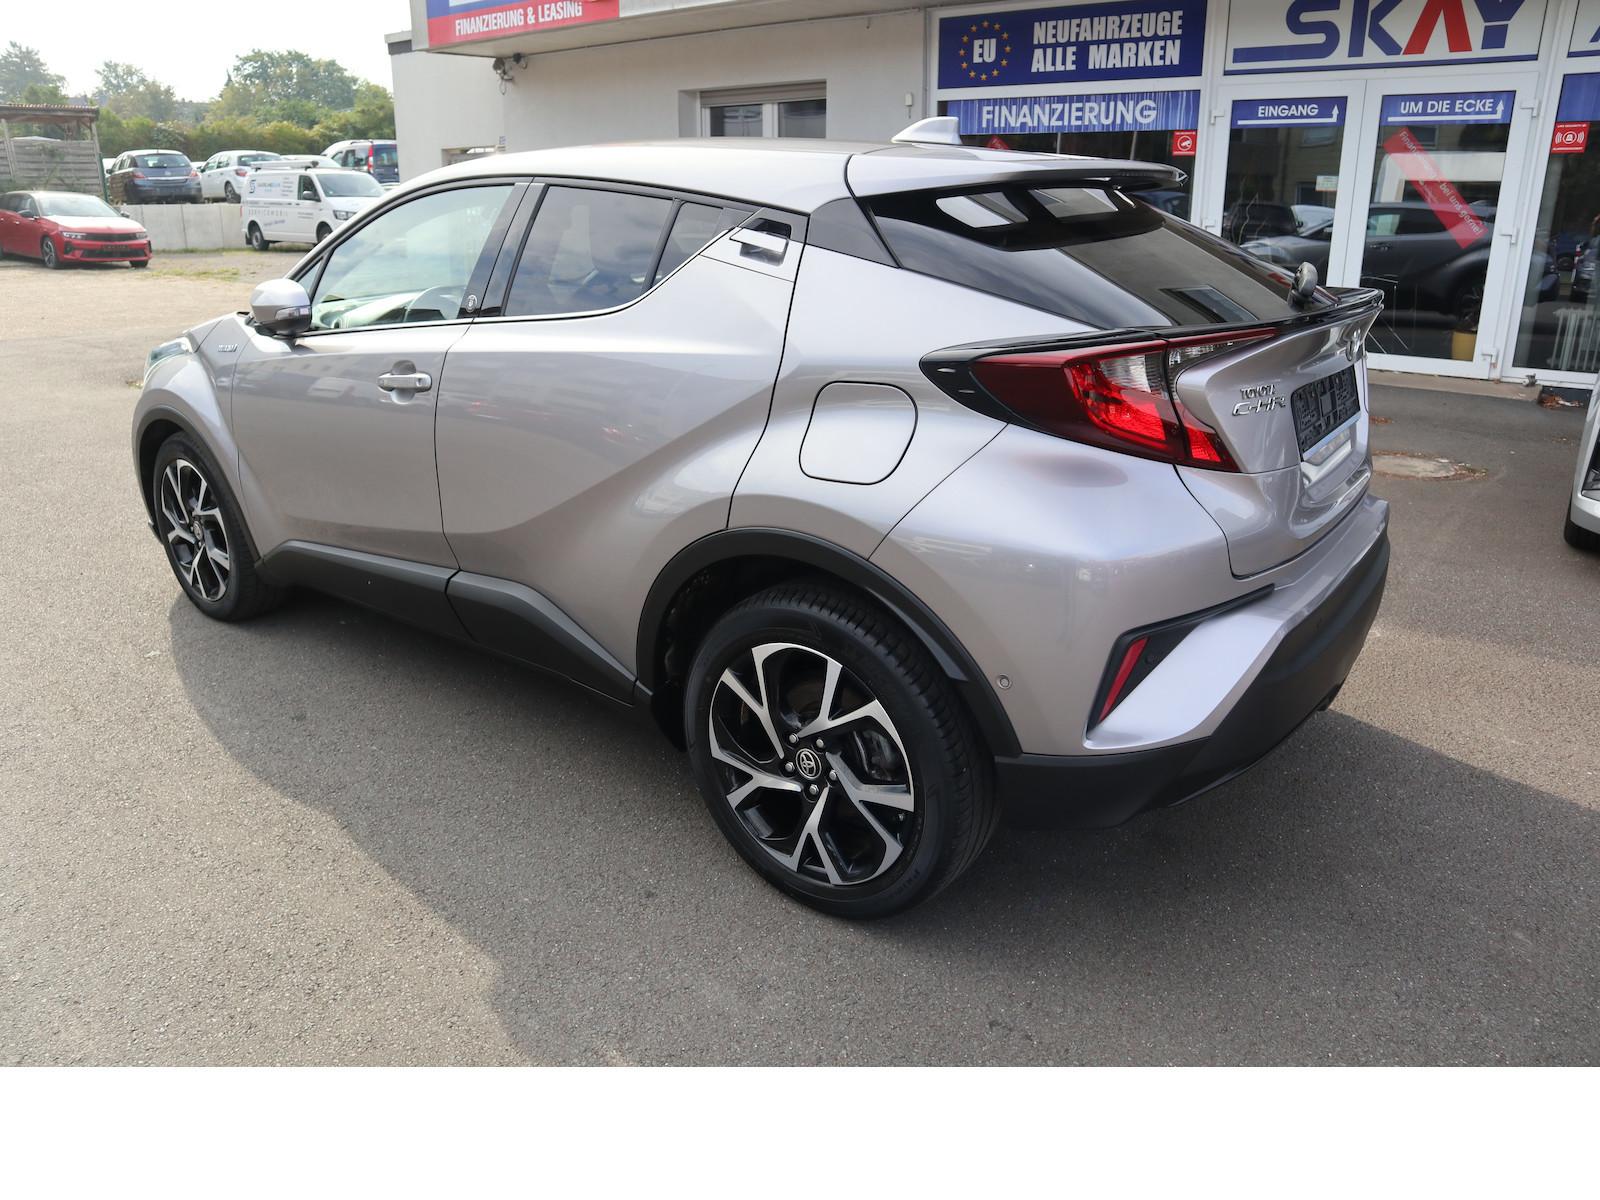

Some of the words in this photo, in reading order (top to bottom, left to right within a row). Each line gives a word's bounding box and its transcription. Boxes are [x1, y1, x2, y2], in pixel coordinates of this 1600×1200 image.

[455, 9, 524, 36] FINANZIERUNG
[527, 7, 535, 24] &
[538, 2, 583, 23] LEASING
[1033, 10, 1184, 45] NEUFAHRZEUGE
[1233, 0, 1523, 64] SKAY
[972, 38, 997, 64] EU
[1031, 46, 1077, 72] ALLE
[1088, 39, 1181, 69] MARKEN
[981, 99, 1157, 128] FINANZIERUNG
[1257, 104, 1319, 118] EINGANG
[1400, 101, 1424, 114] UM
[1427, 100, 1451, 113] DIE
[1454, 99, 1494, 112] ECKE
[1233, 397, 1286, 416] C-HR
